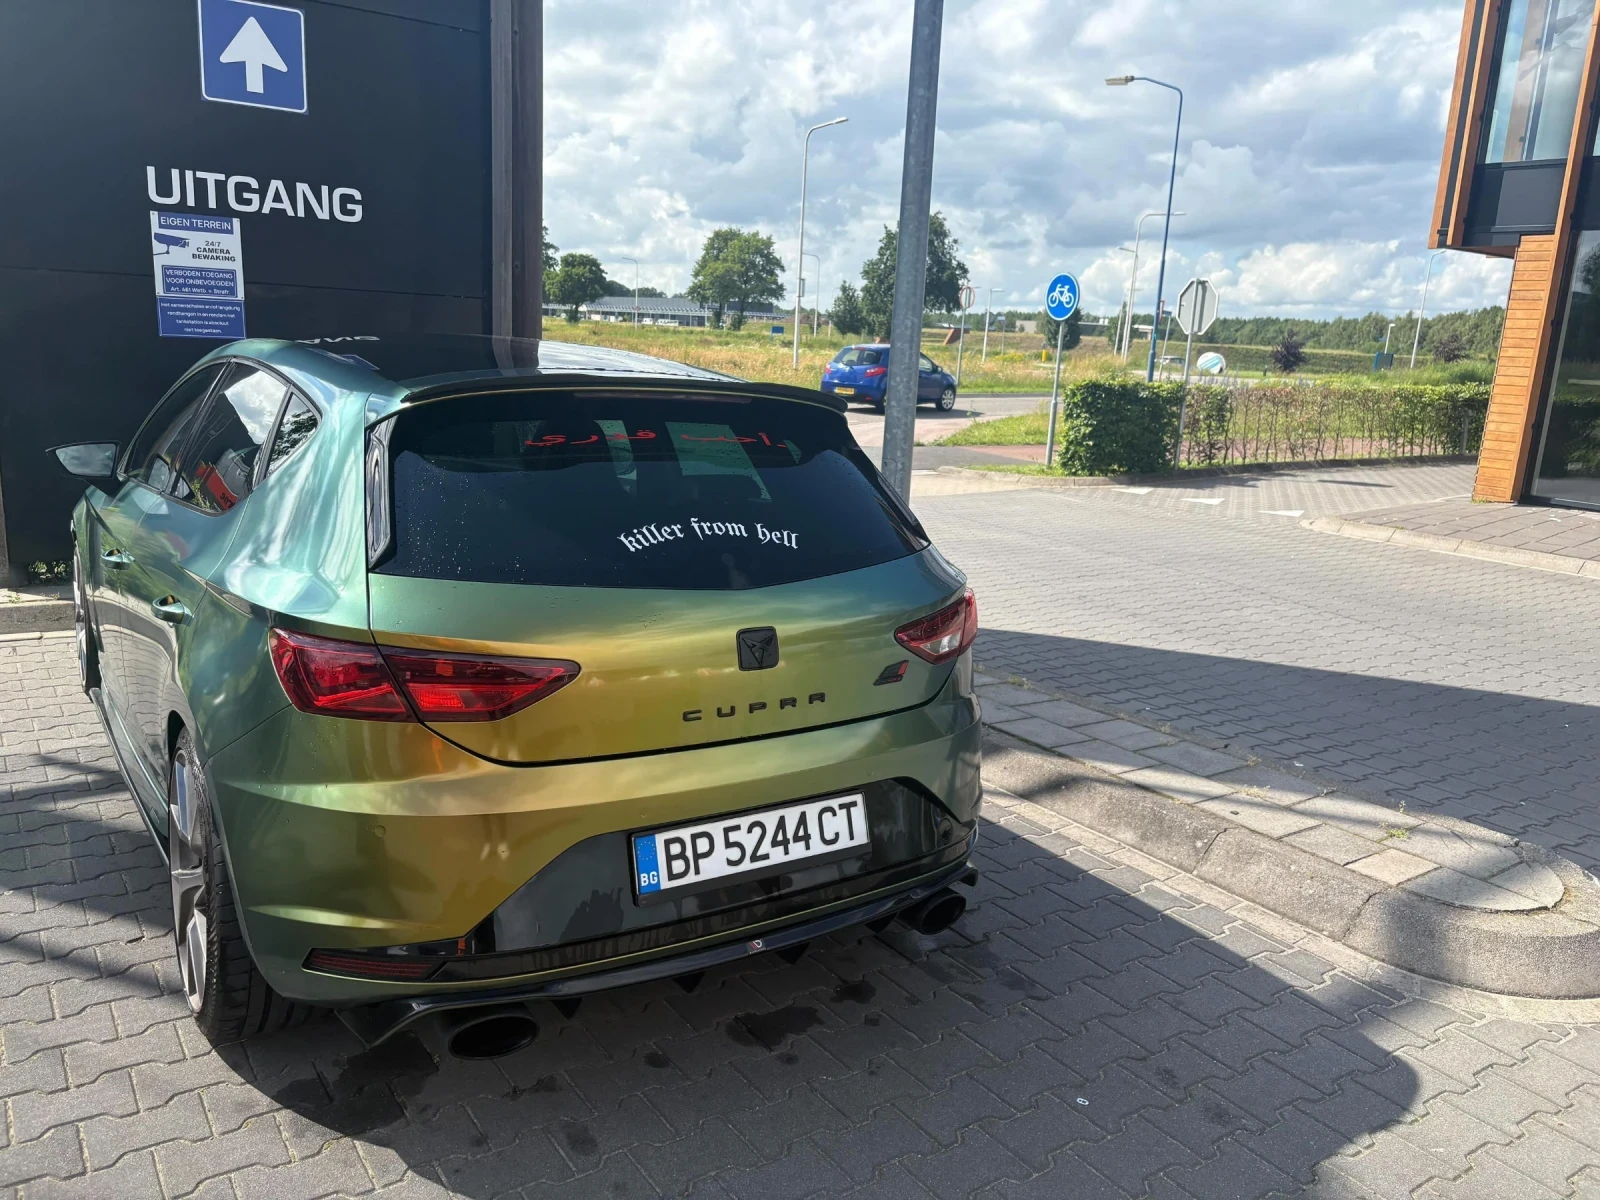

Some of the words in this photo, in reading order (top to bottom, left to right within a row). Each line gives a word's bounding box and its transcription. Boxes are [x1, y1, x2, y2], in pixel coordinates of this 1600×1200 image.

[147, 166, 363, 223] UITGANG
[160, 216, 190, 226] EIGEN
[191, 219, 231, 230] TERREIN
[192, 254, 236, 262] BEWAKING
[186, 278, 234, 286] ONBEVOEGDEN
[617, 522, 684, 552] killer
[690, 517, 748, 540] from
[754, 522, 800, 550] hell
[682, 692, 826, 722] CUPRA
[640, 871, 658, 887] BG
